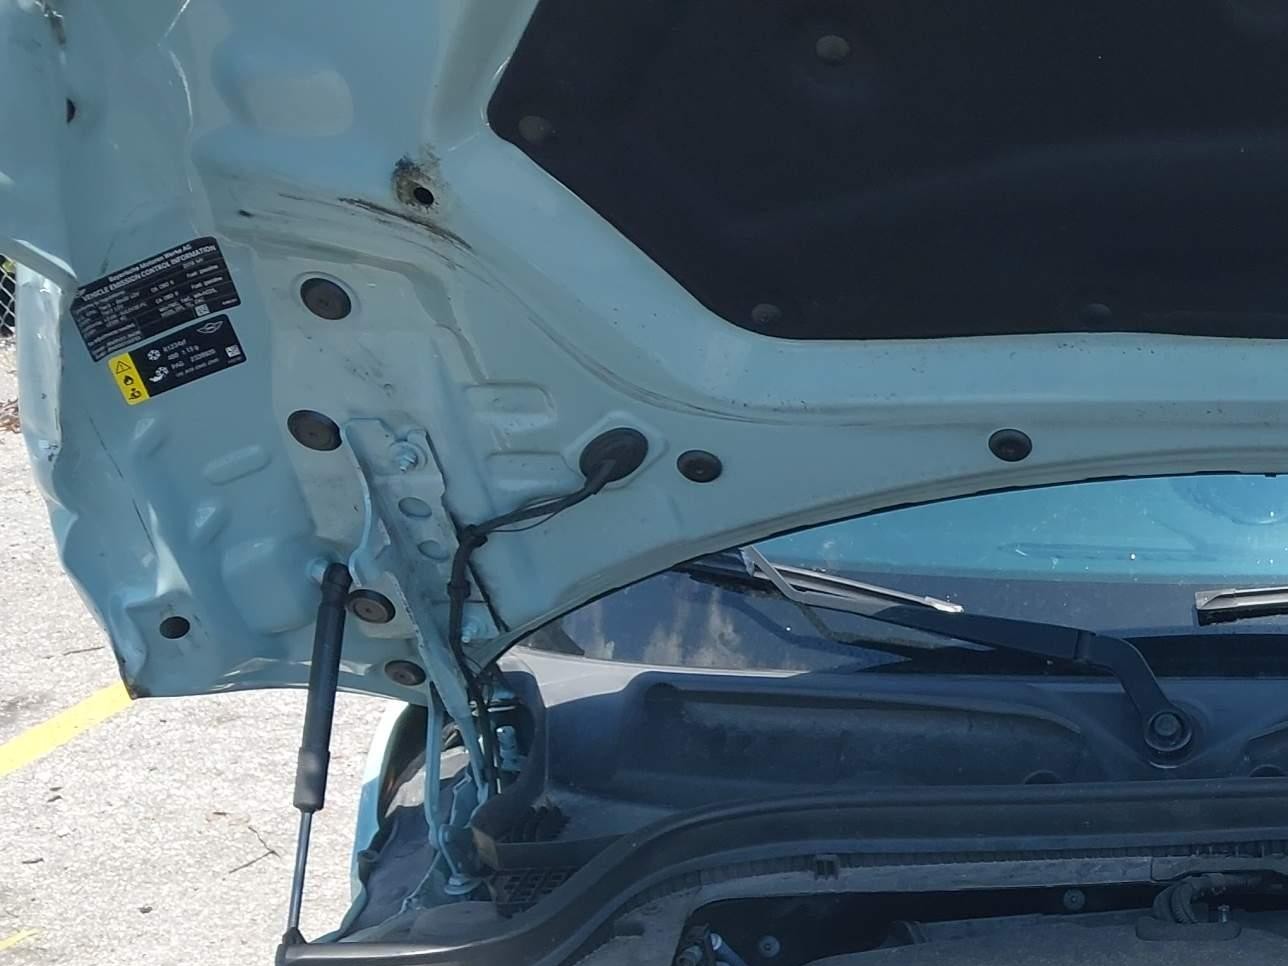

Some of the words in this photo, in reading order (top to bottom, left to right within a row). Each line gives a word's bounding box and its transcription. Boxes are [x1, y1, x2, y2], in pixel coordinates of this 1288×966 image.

[82, 286, 109, 301] VEHICLE
[109, 273, 141, 290] EMISSION
[140, 261, 170, 277] CONTROL
[170, 244, 216, 265] INFORMATION
